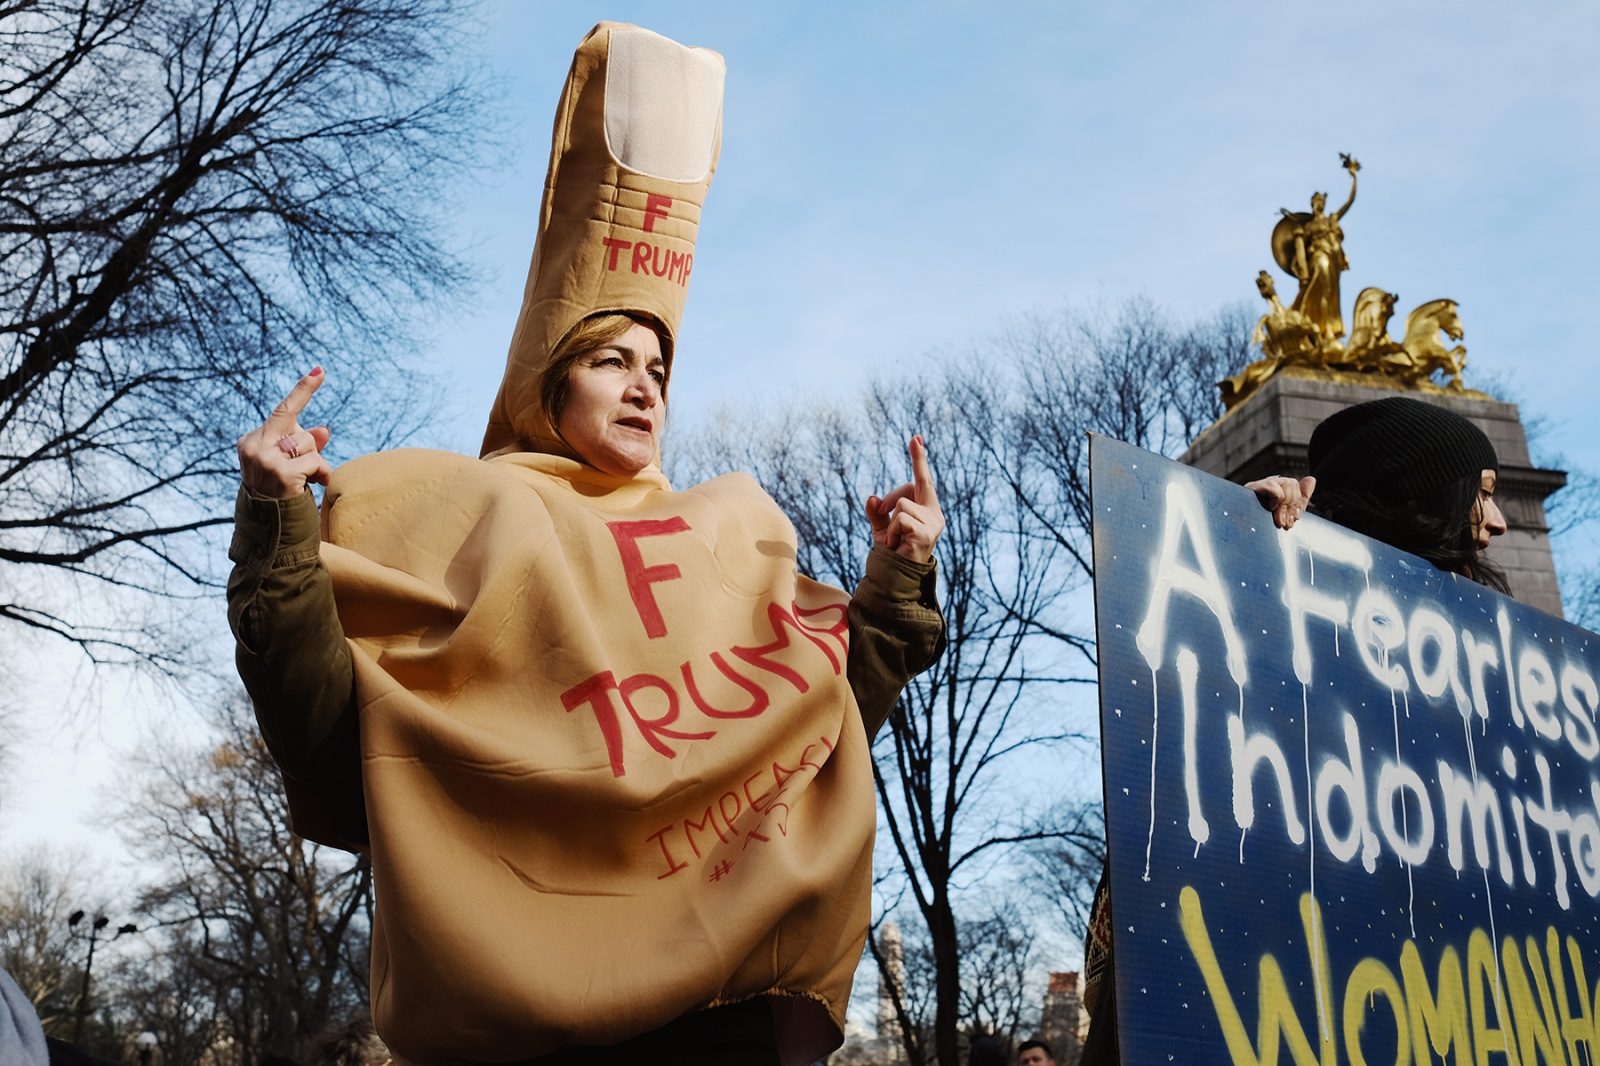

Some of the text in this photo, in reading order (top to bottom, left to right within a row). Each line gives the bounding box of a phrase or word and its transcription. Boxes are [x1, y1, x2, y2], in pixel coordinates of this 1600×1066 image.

[602, 236, 693, 287] TRUMP
[642, 193, 672, 233] F
[605, 515, 692, 640] F
[1135, 476, 1248, 688] A
[560, 600, 850, 778] TRUMP
[1175, 648, 1600, 911] Indomita
[1178, 885, 1600, 1066] WOMANH
